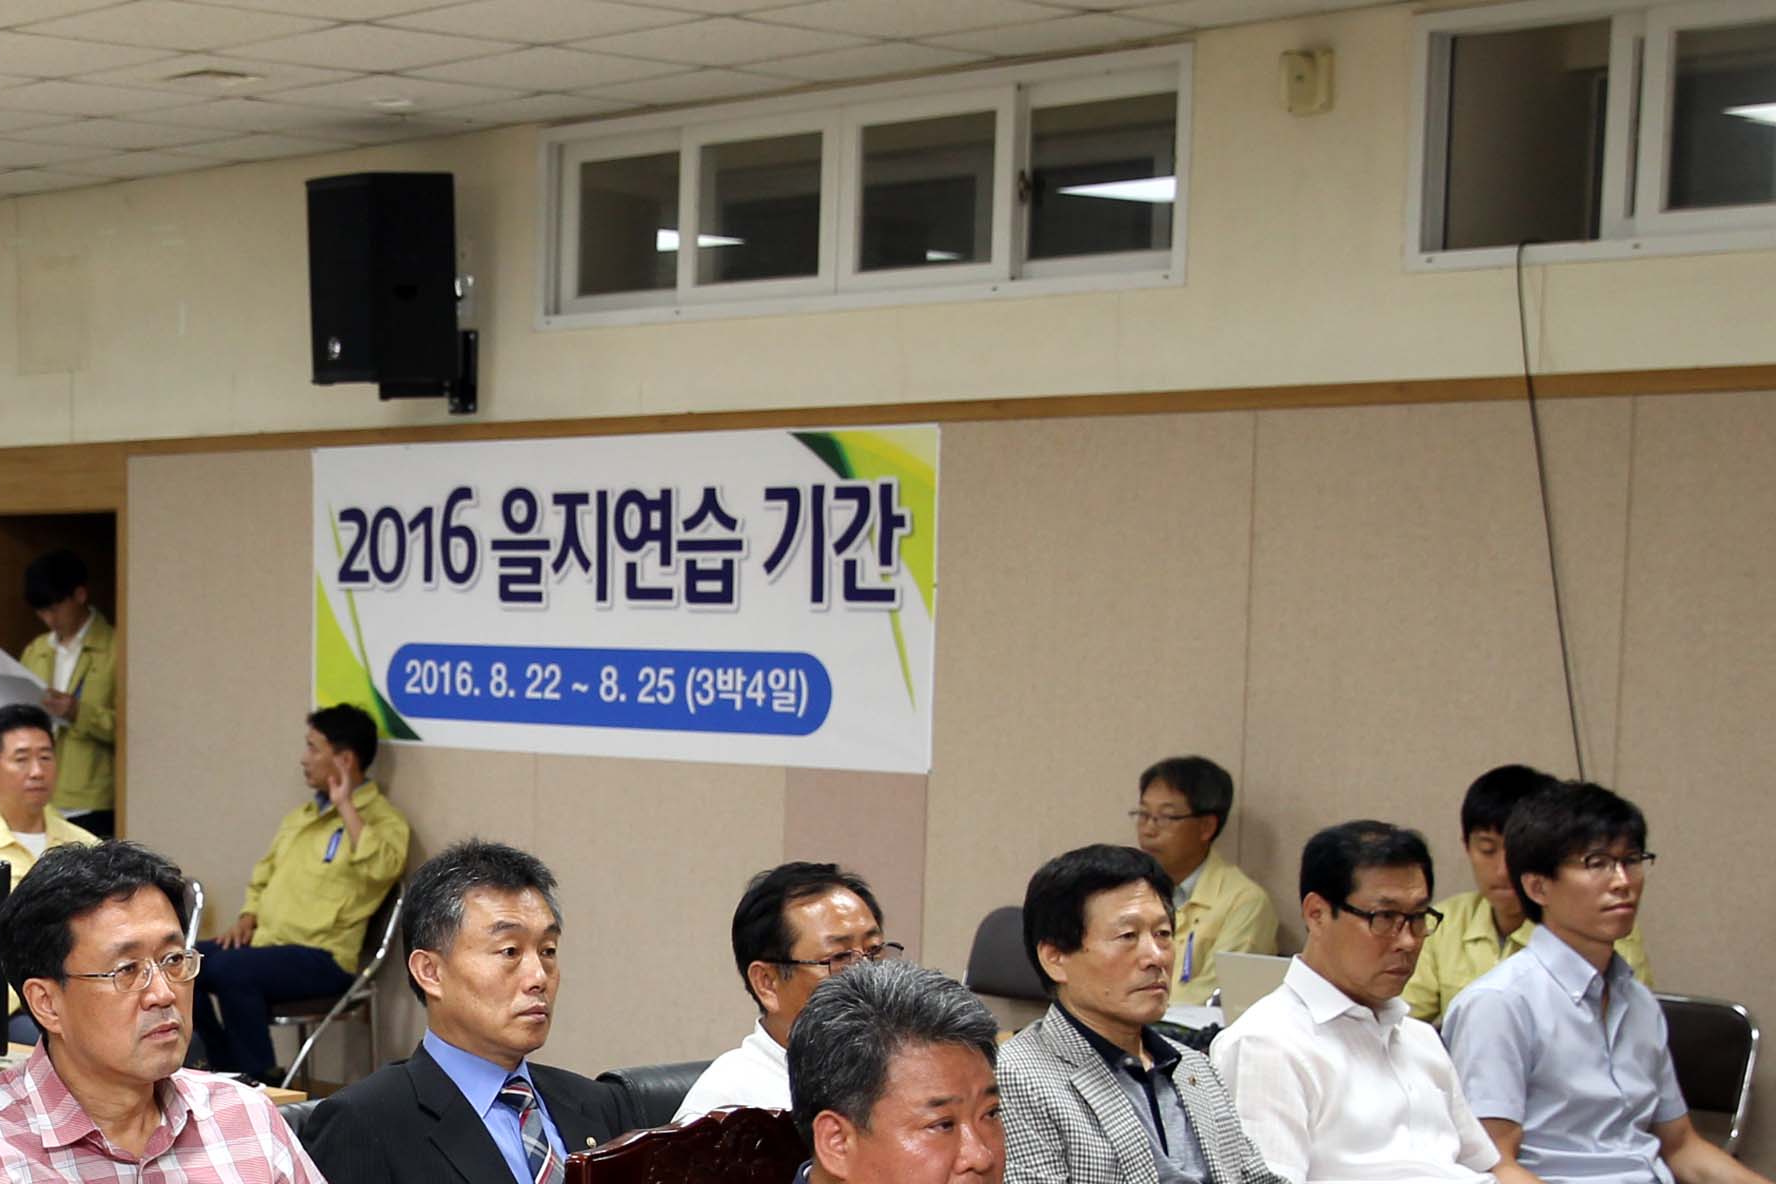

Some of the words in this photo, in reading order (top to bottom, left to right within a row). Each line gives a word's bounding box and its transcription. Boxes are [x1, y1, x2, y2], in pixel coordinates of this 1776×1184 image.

[336, 485, 479, 585] 2016
[490, 485, 743, 605] 을지연습
[763, 483, 906, 605] 기간
[405, 659, 481, 696] 2016.
[489, 662, 516, 698] 8.
[525, 663, 562, 700] 22
[599, 665, 627, 702] 8.
[637, 666, 676, 704] 25
[685, 667, 809, 718] (3박4일)
